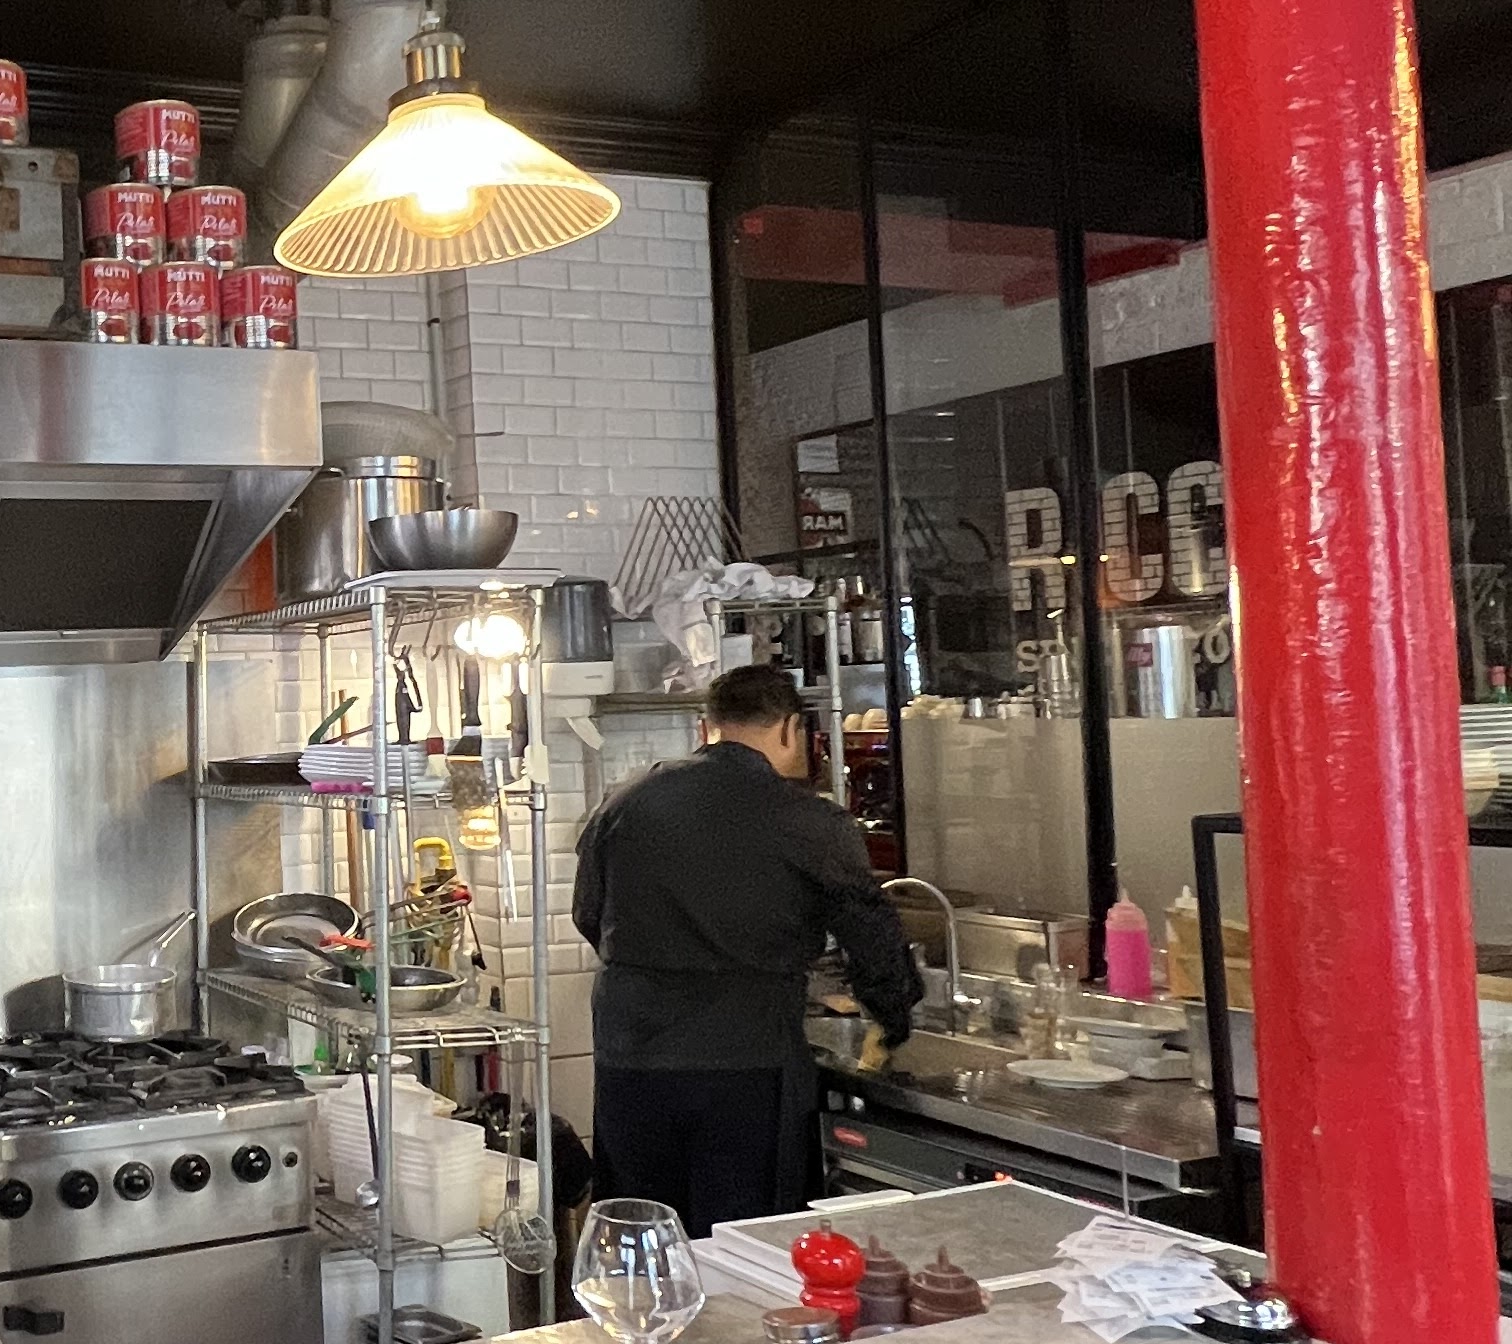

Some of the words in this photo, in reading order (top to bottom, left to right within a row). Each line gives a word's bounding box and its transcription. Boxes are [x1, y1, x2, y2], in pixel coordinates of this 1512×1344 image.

[161, 109, 195, 123] MUTTI
[118, 192, 154, 204] MUTTI
[201, 192, 237, 206] MUTTI
[94, 264, 129, 279] MUTTI
[167, 269, 205, 282] MUTTI
[260, 273, 293, 286] MUTTI
